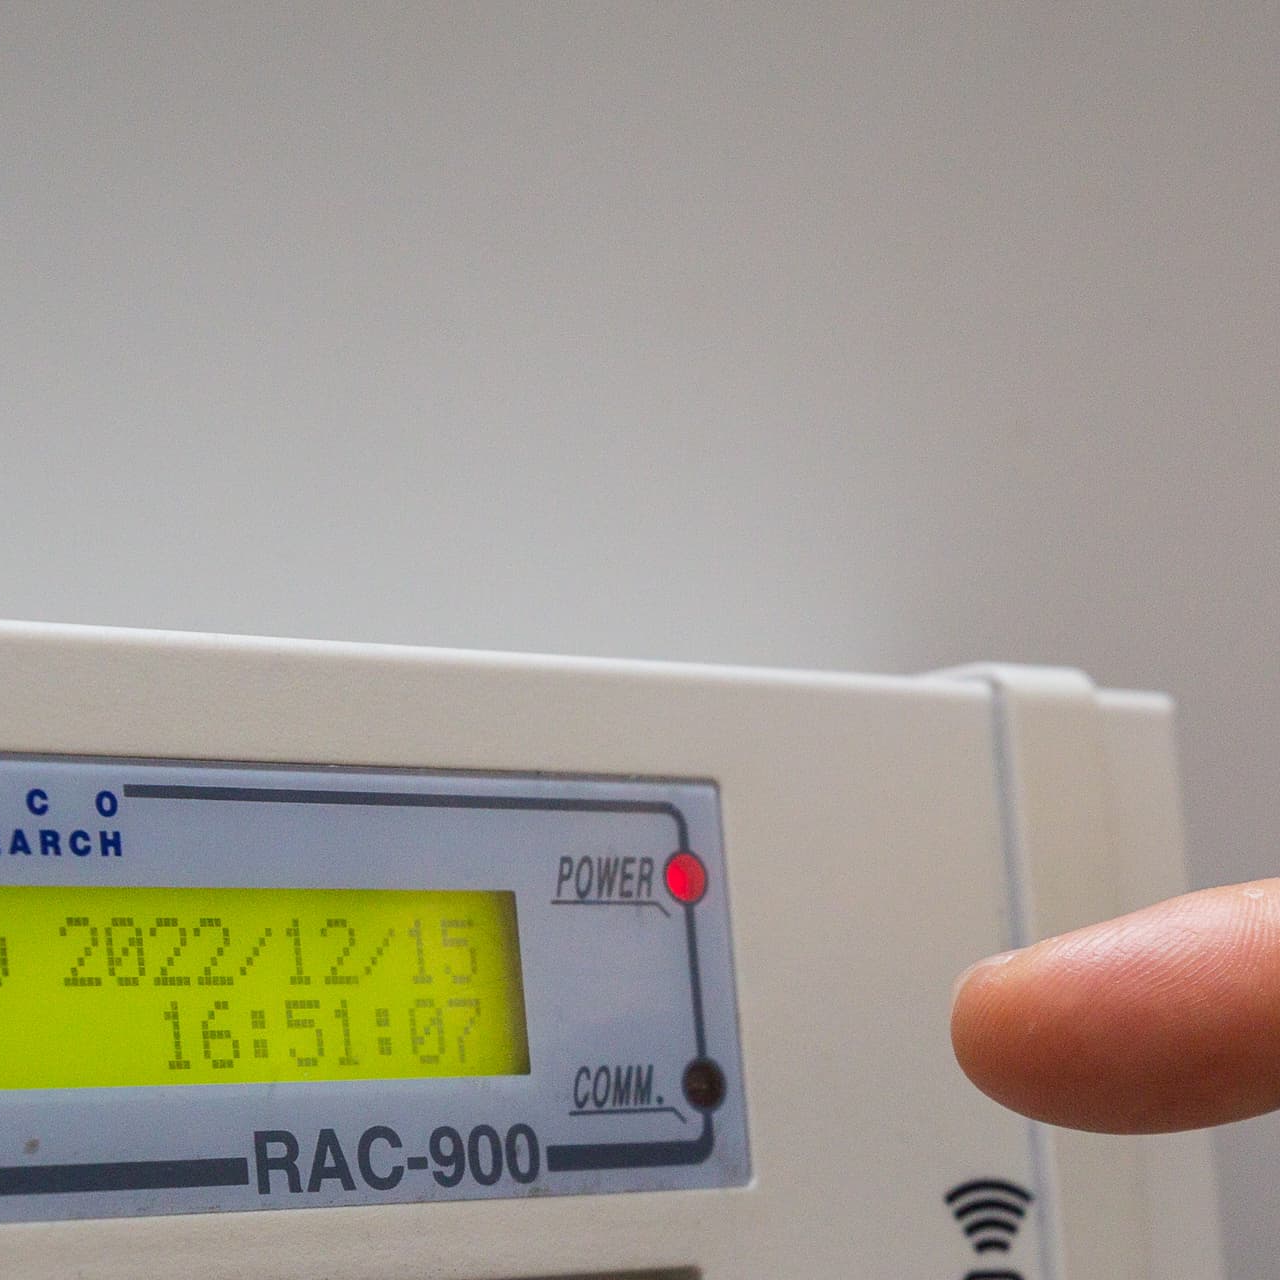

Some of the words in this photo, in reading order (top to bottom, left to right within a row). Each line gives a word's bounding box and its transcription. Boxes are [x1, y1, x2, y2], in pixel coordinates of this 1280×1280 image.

[556, 855, 654, 899] POWER
[58, 917, 479, 986] 2022/12/15
[164, 999, 481, 1069] 16:51:07
[573, 1064, 664, 1107] COMM.
[253, 1123, 541, 1194] RAC-900
